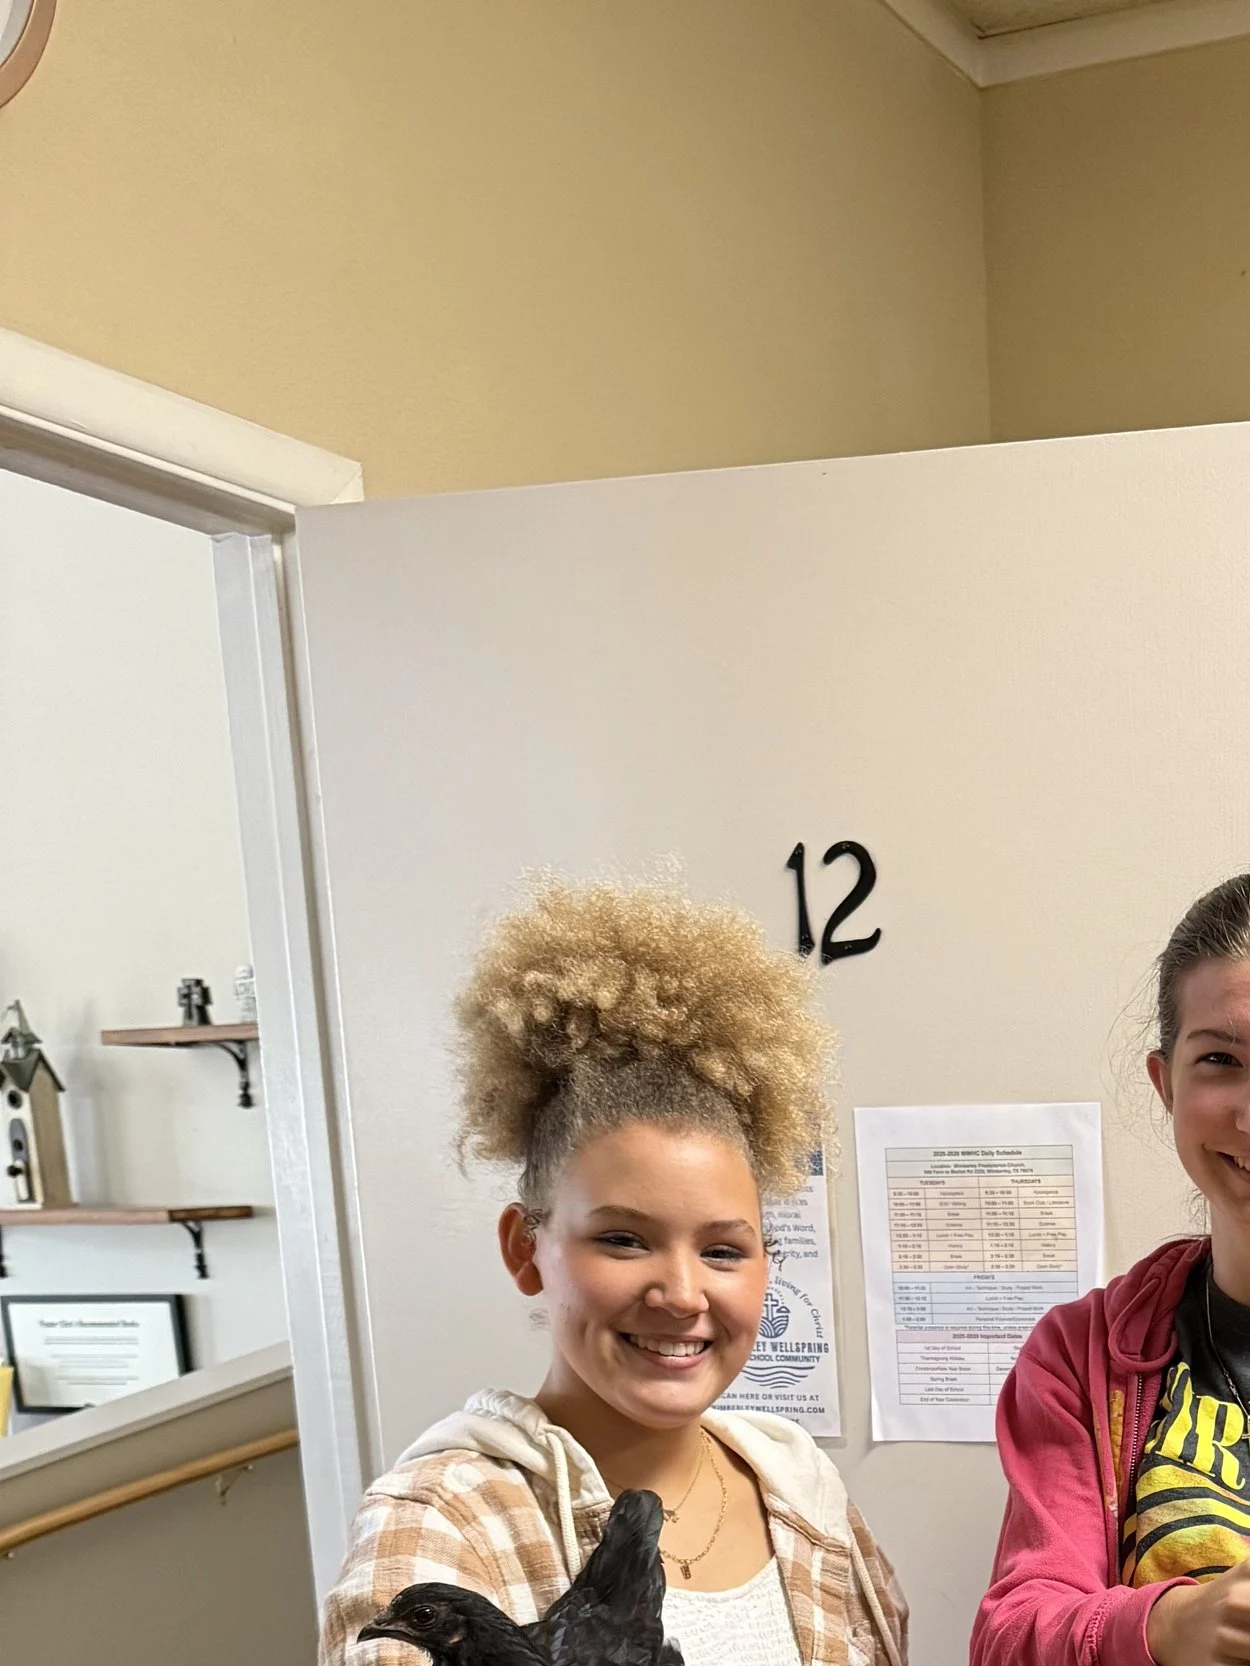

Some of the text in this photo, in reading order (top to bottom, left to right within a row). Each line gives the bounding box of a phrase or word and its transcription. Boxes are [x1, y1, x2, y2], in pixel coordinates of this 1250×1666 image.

[787, 840, 882, 966] 12
[774, 1224, 792, 1233] od's
[783, 1236, 817, 1246] families,
[803, 1249, 819, 1258] and
[774, 1275, 824, 1339] living for Christ
[769, 1341, 830, 1354] WELLSPRING
[748, 1354, 821, 1364] CHOOL COMMUNITY
[739, 1393, 760, 1401] HERE
[762, 1393, 773, 1401] OR
[774, 1393, 794, 1401] VISIT
[810, 1394, 819, 1402] AT
